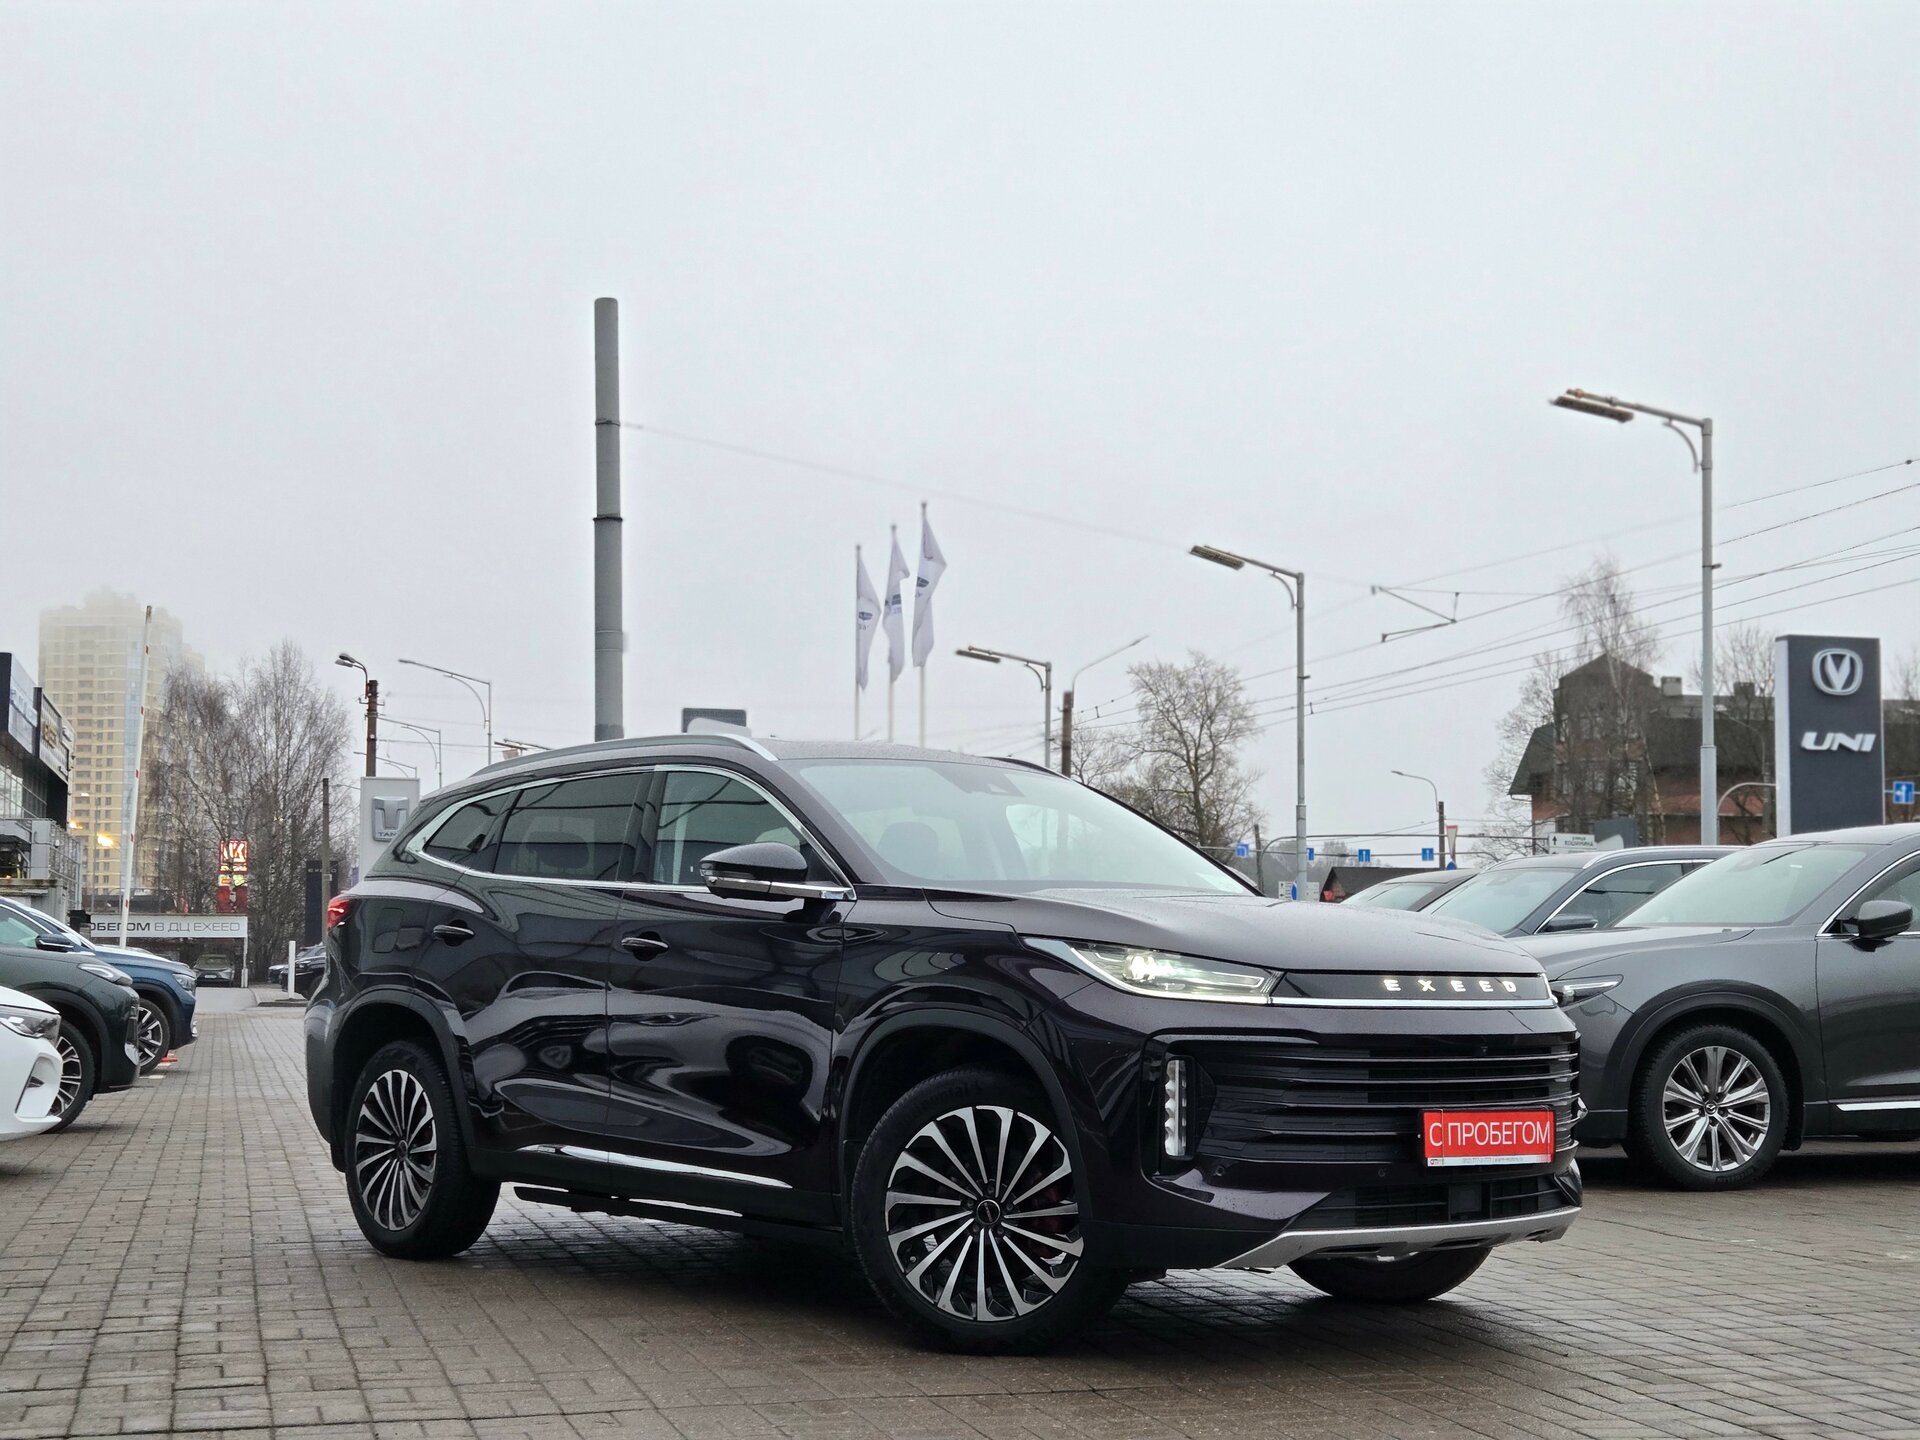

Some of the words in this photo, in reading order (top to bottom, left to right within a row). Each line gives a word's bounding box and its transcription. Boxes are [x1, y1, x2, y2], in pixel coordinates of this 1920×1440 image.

[1801, 731, 1876, 752] UNI
[154, 922, 165, 931] В
[168, 922, 190, 932] ДЦ
[193, 922, 240, 932] EXEED
[1383, 979, 1517, 993] EXEED
[1429, 1122, 1443, 1147] С
[1448, 1121, 1551, 1146] ПРОБЕГОМ
